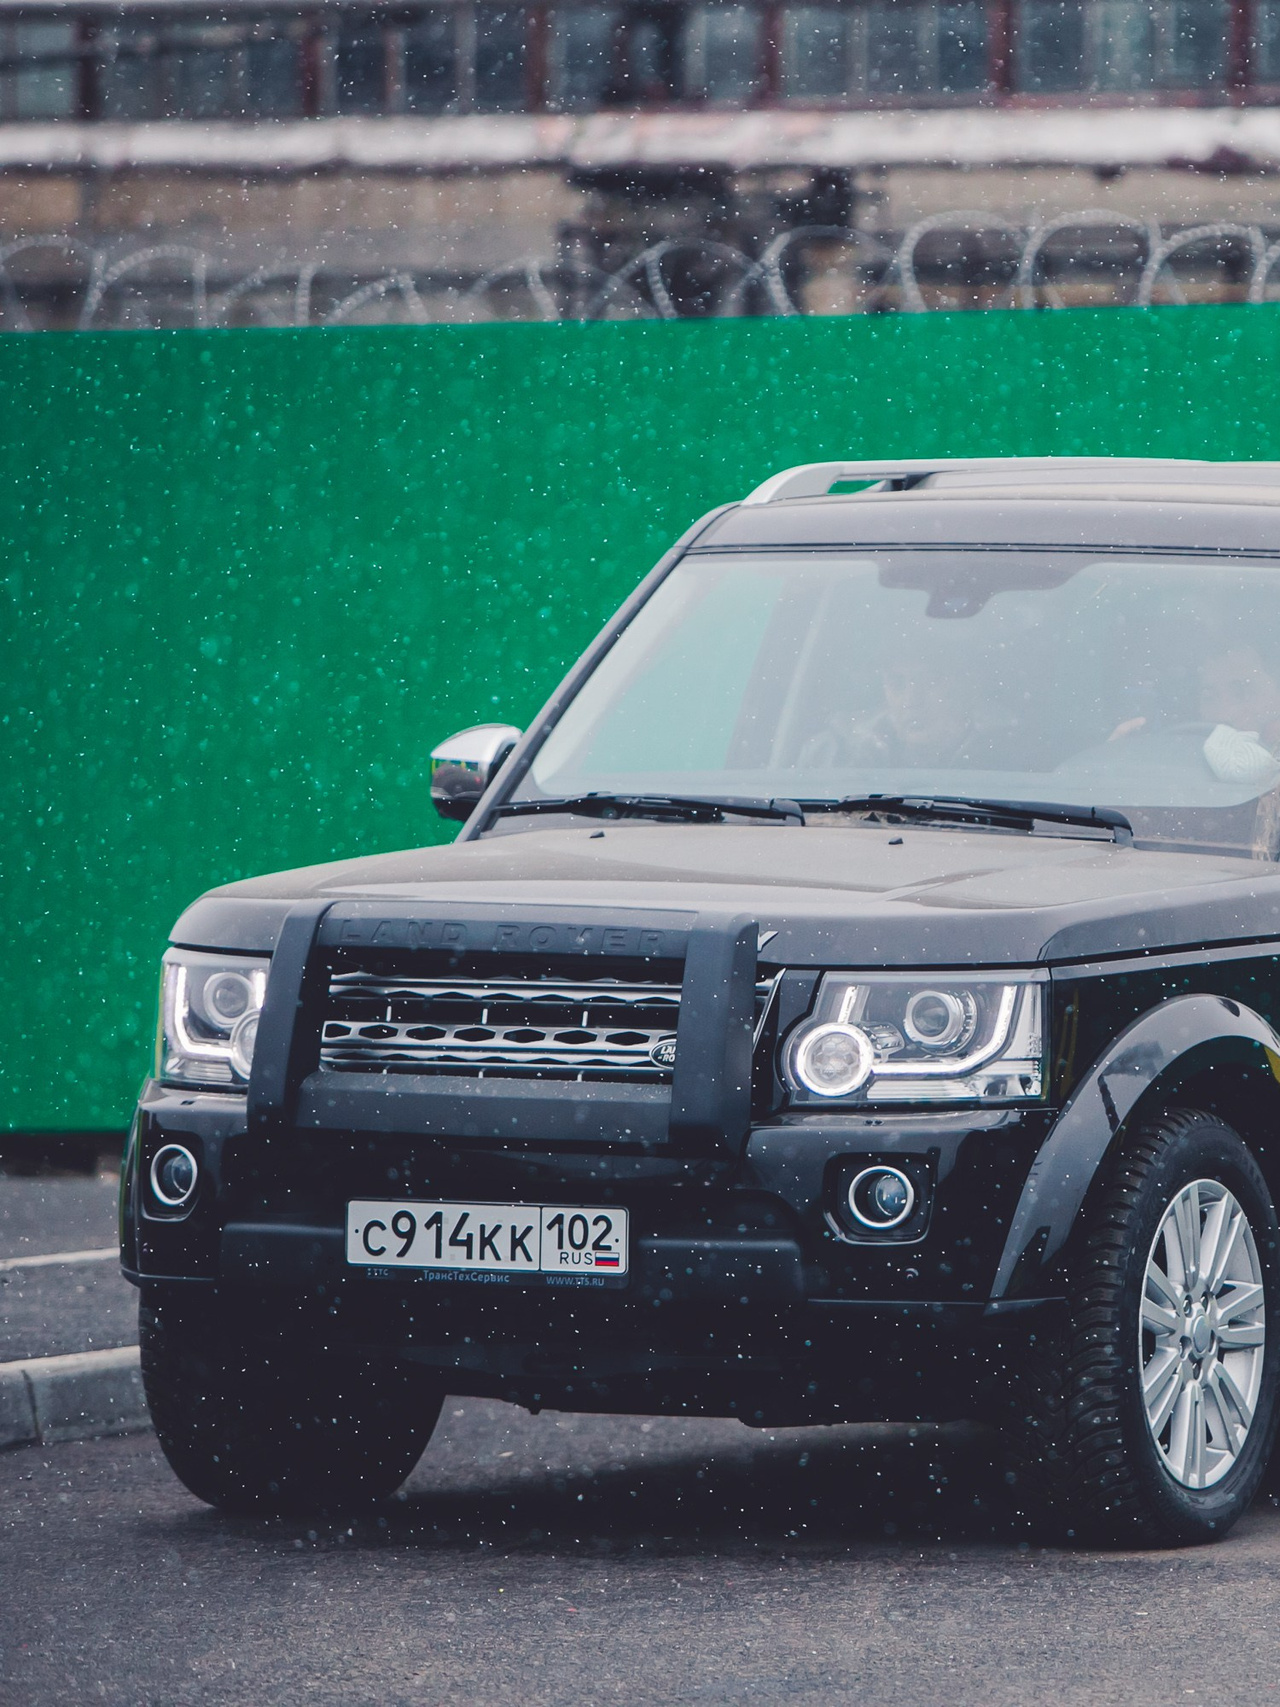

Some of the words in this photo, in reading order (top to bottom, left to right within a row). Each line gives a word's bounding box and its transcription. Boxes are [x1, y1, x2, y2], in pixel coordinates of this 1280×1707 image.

[338, 918, 469, 946] LAND
[493, 923, 668, 953] ROVER
[545, 1212, 614, 1252] 102
[559, 1251, 594, 1265] RUS
[422, 1269, 511, 1284] ТрансТехСервис
[546, 1275, 605, 1287] WWW.TTS.RU
